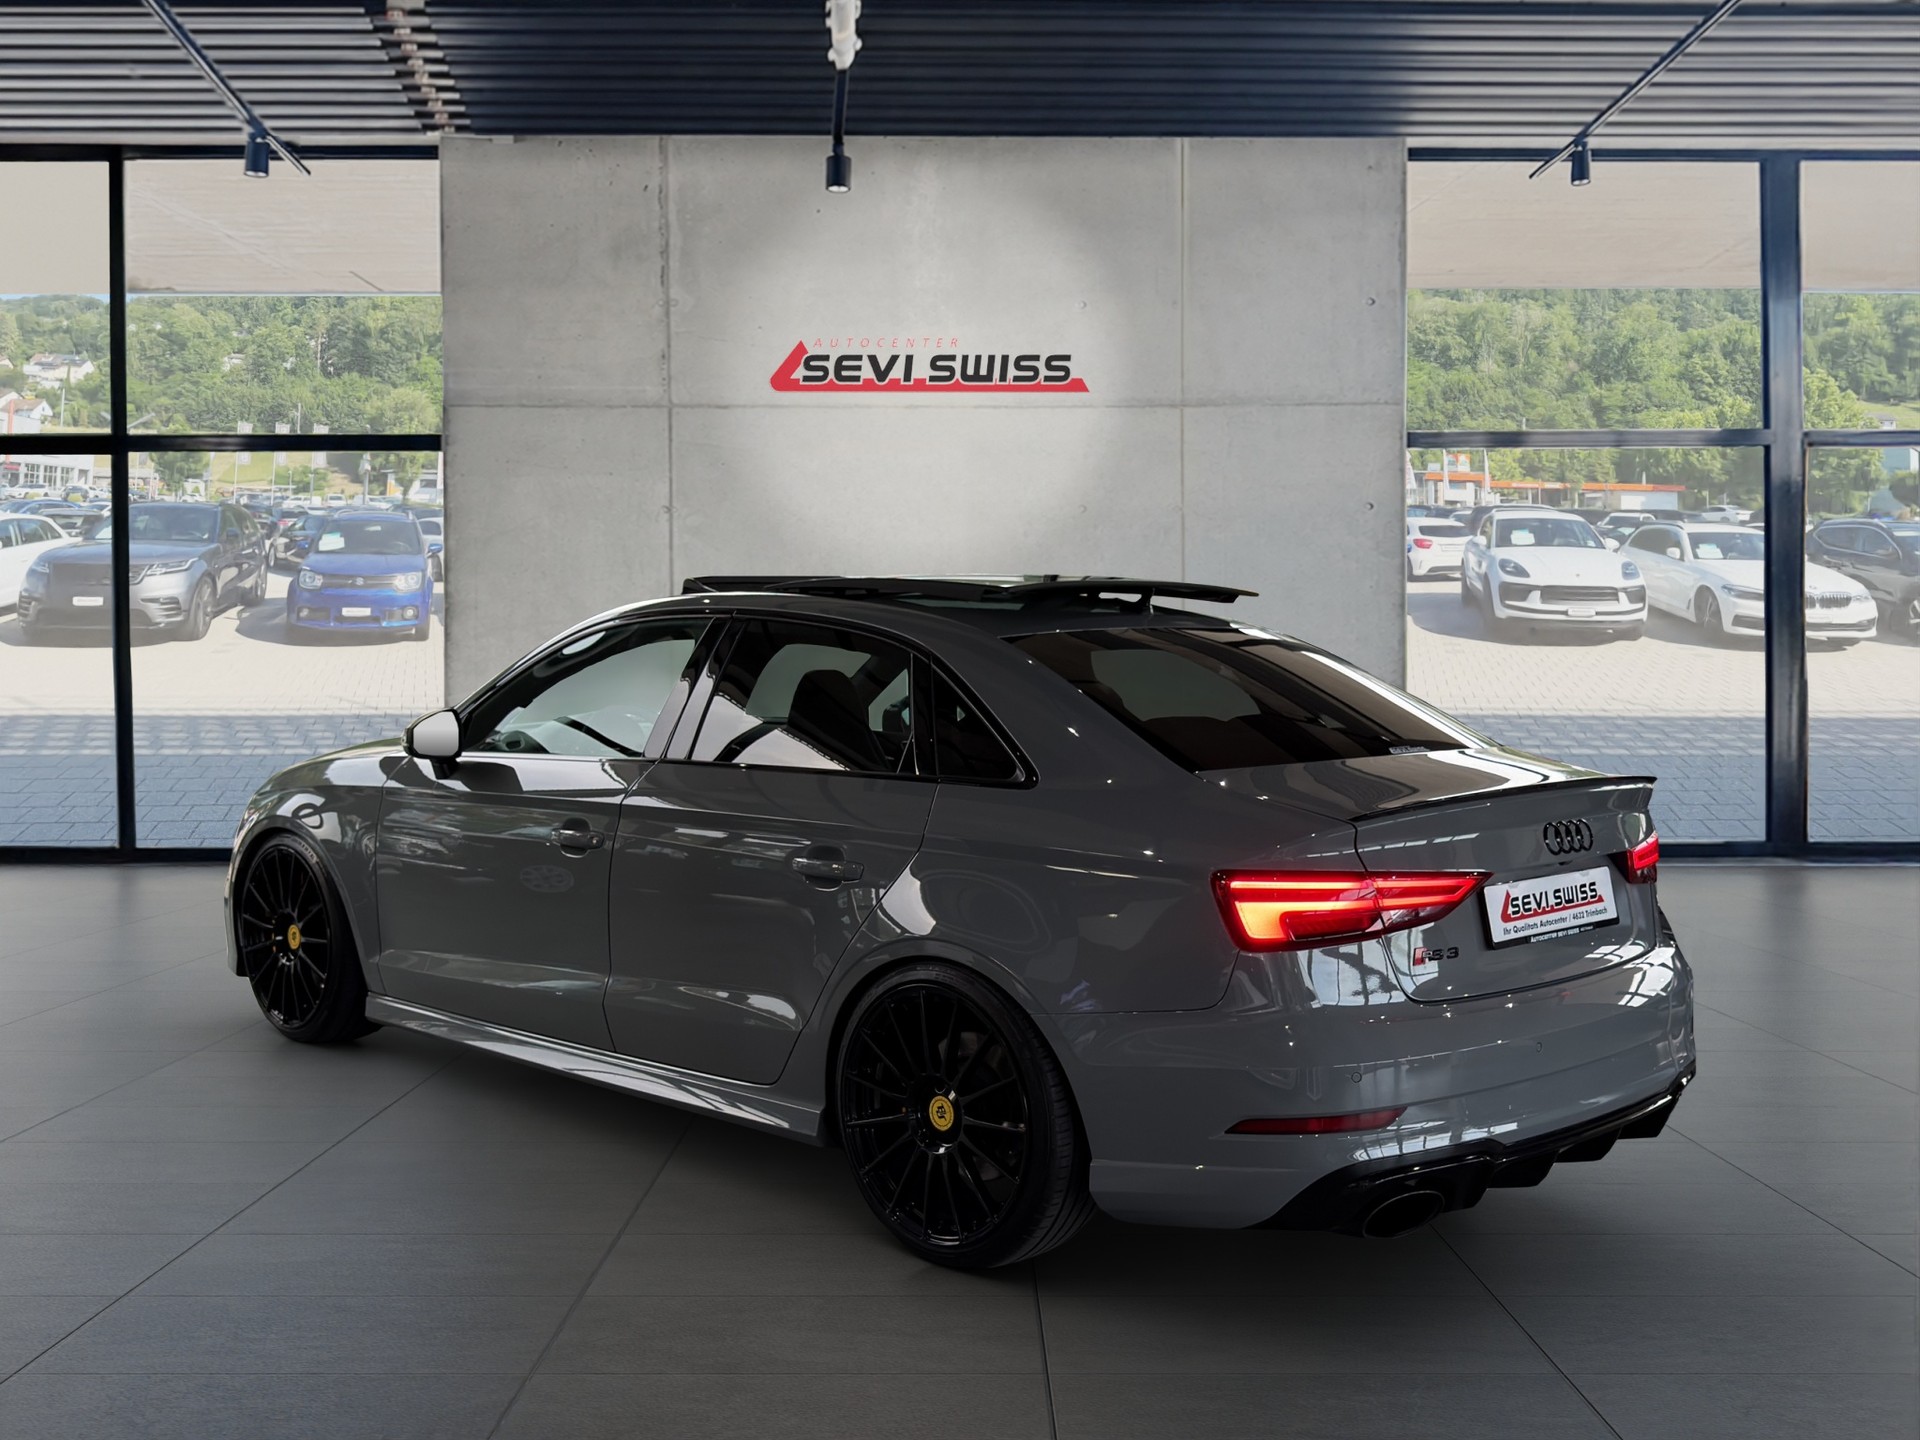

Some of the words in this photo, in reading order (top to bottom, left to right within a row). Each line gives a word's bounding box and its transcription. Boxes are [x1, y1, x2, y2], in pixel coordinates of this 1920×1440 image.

[813, 337, 958, 349] AUTOCENTER
[801, 354, 914, 383] SEVI
[928, 354, 1072, 383] SWISS
[1510, 890, 1549, 916] SEVI
[1553, 881, 1597, 907] SWISS
[1503, 927, 1512, 935] Ihr
[1540, 915, 1568, 927] Autocenter
[1585, 906, 1608, 918] Trimbach
[1446, 946, 1459, 960] 3
